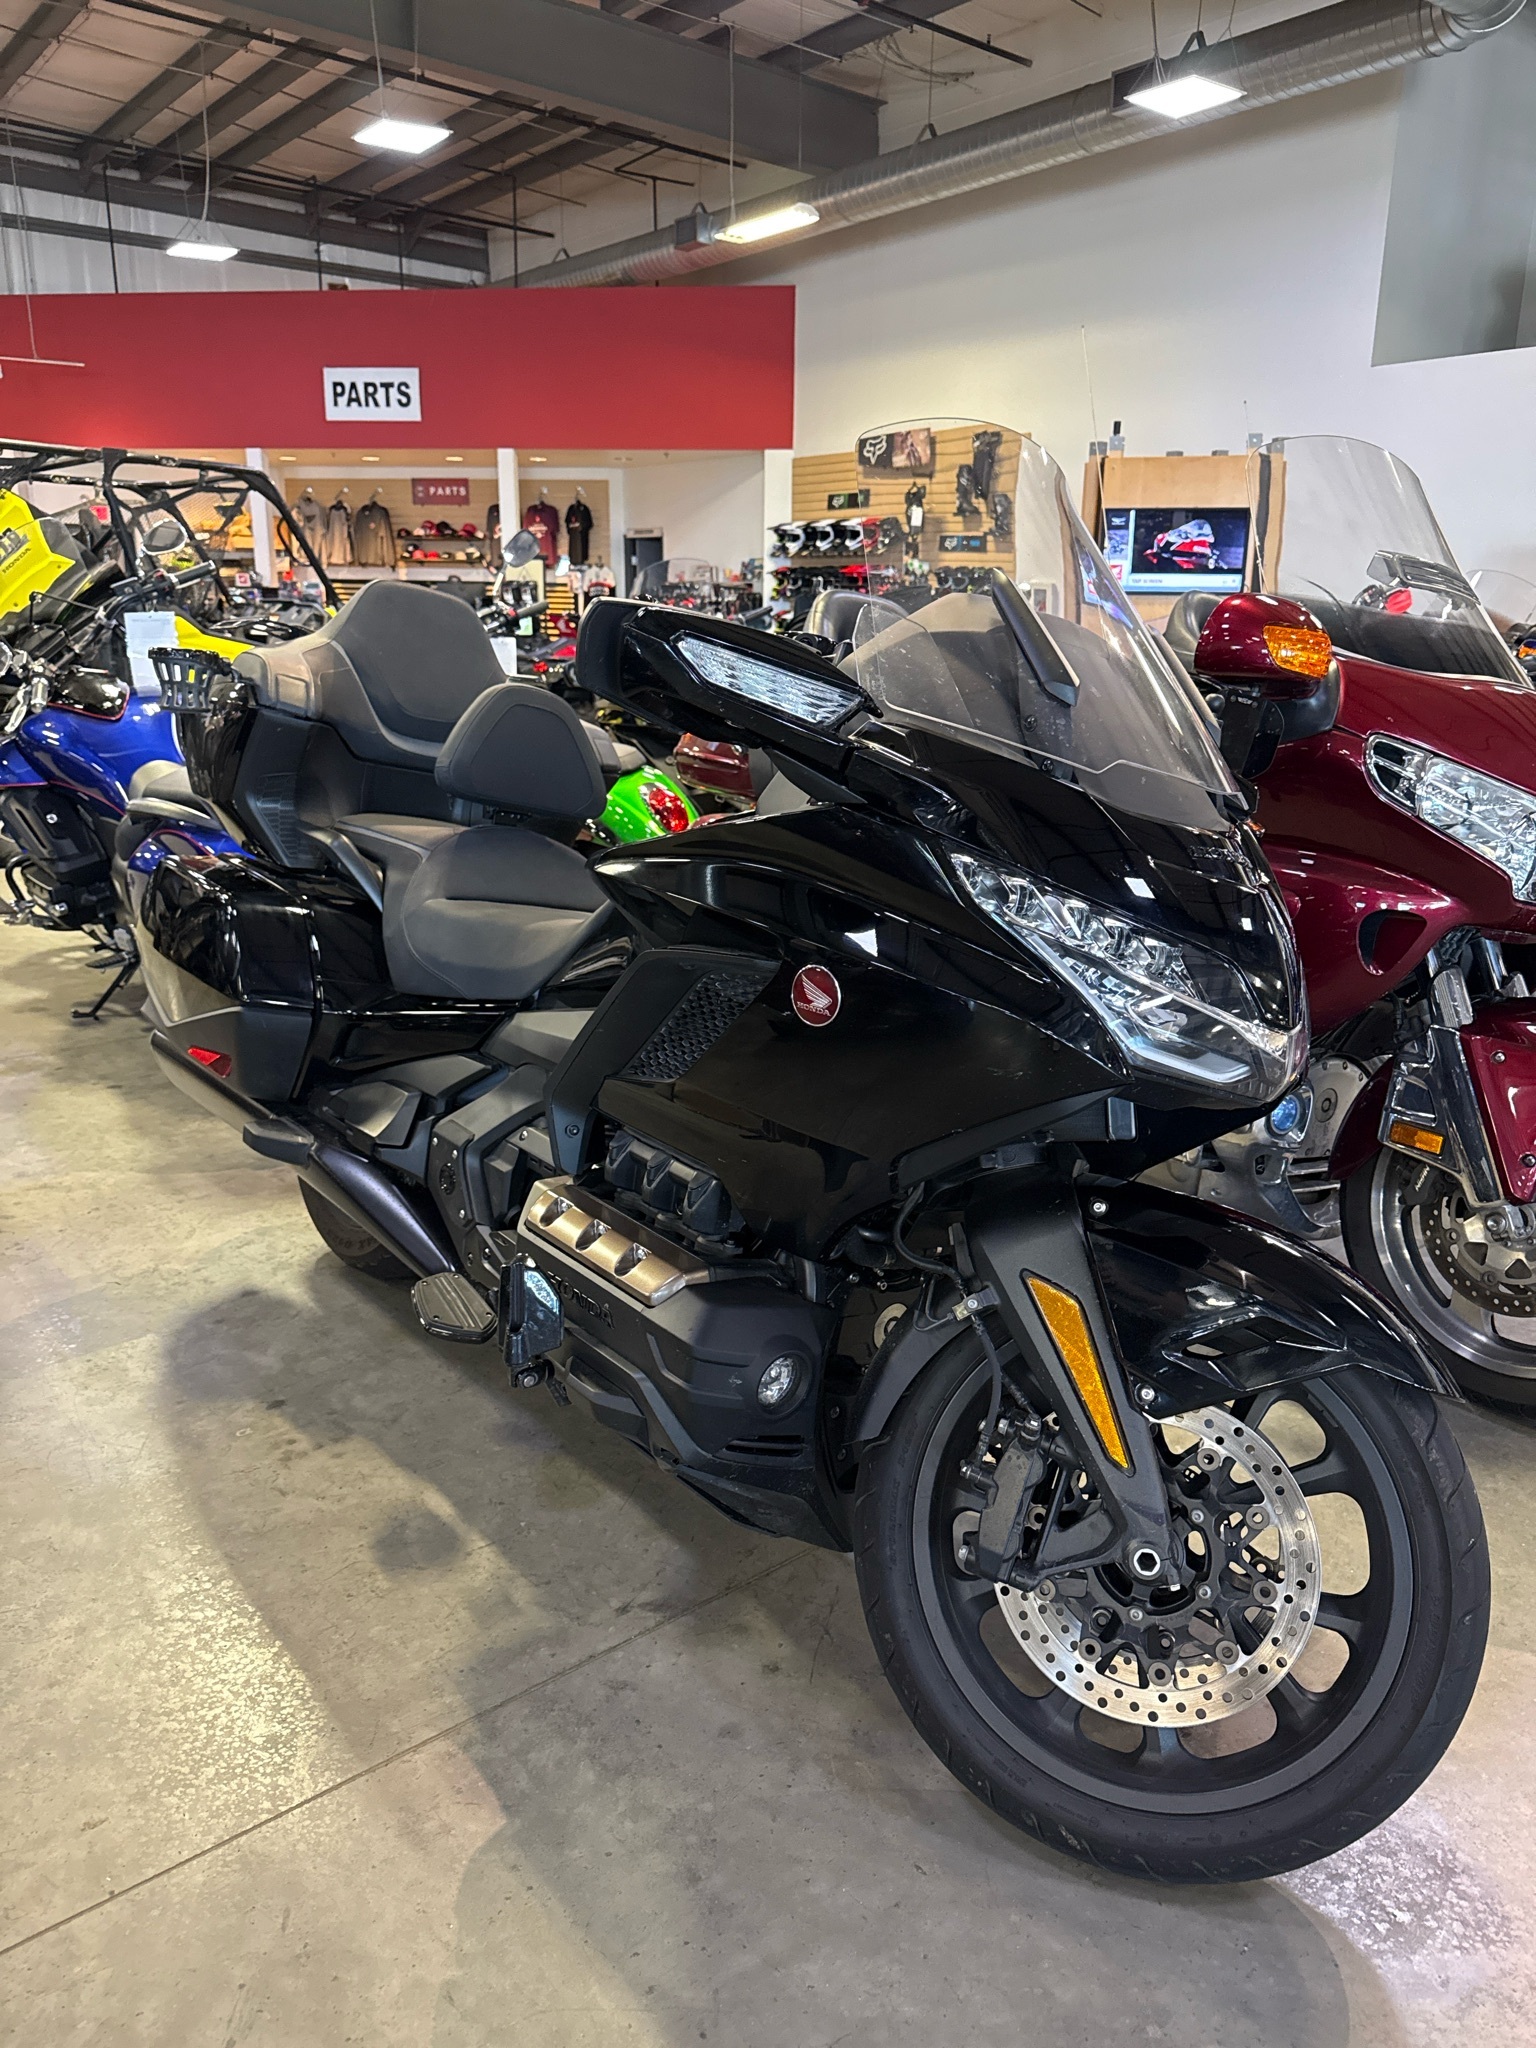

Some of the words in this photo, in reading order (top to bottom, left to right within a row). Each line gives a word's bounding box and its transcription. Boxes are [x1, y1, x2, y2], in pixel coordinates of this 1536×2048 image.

[332, 381, 412, 408] PARTS
[429, 486, 467, 496] PARTS
[2, 547, 31, 574] HONDA
[796, 1001, 832, 1016] HONDA
